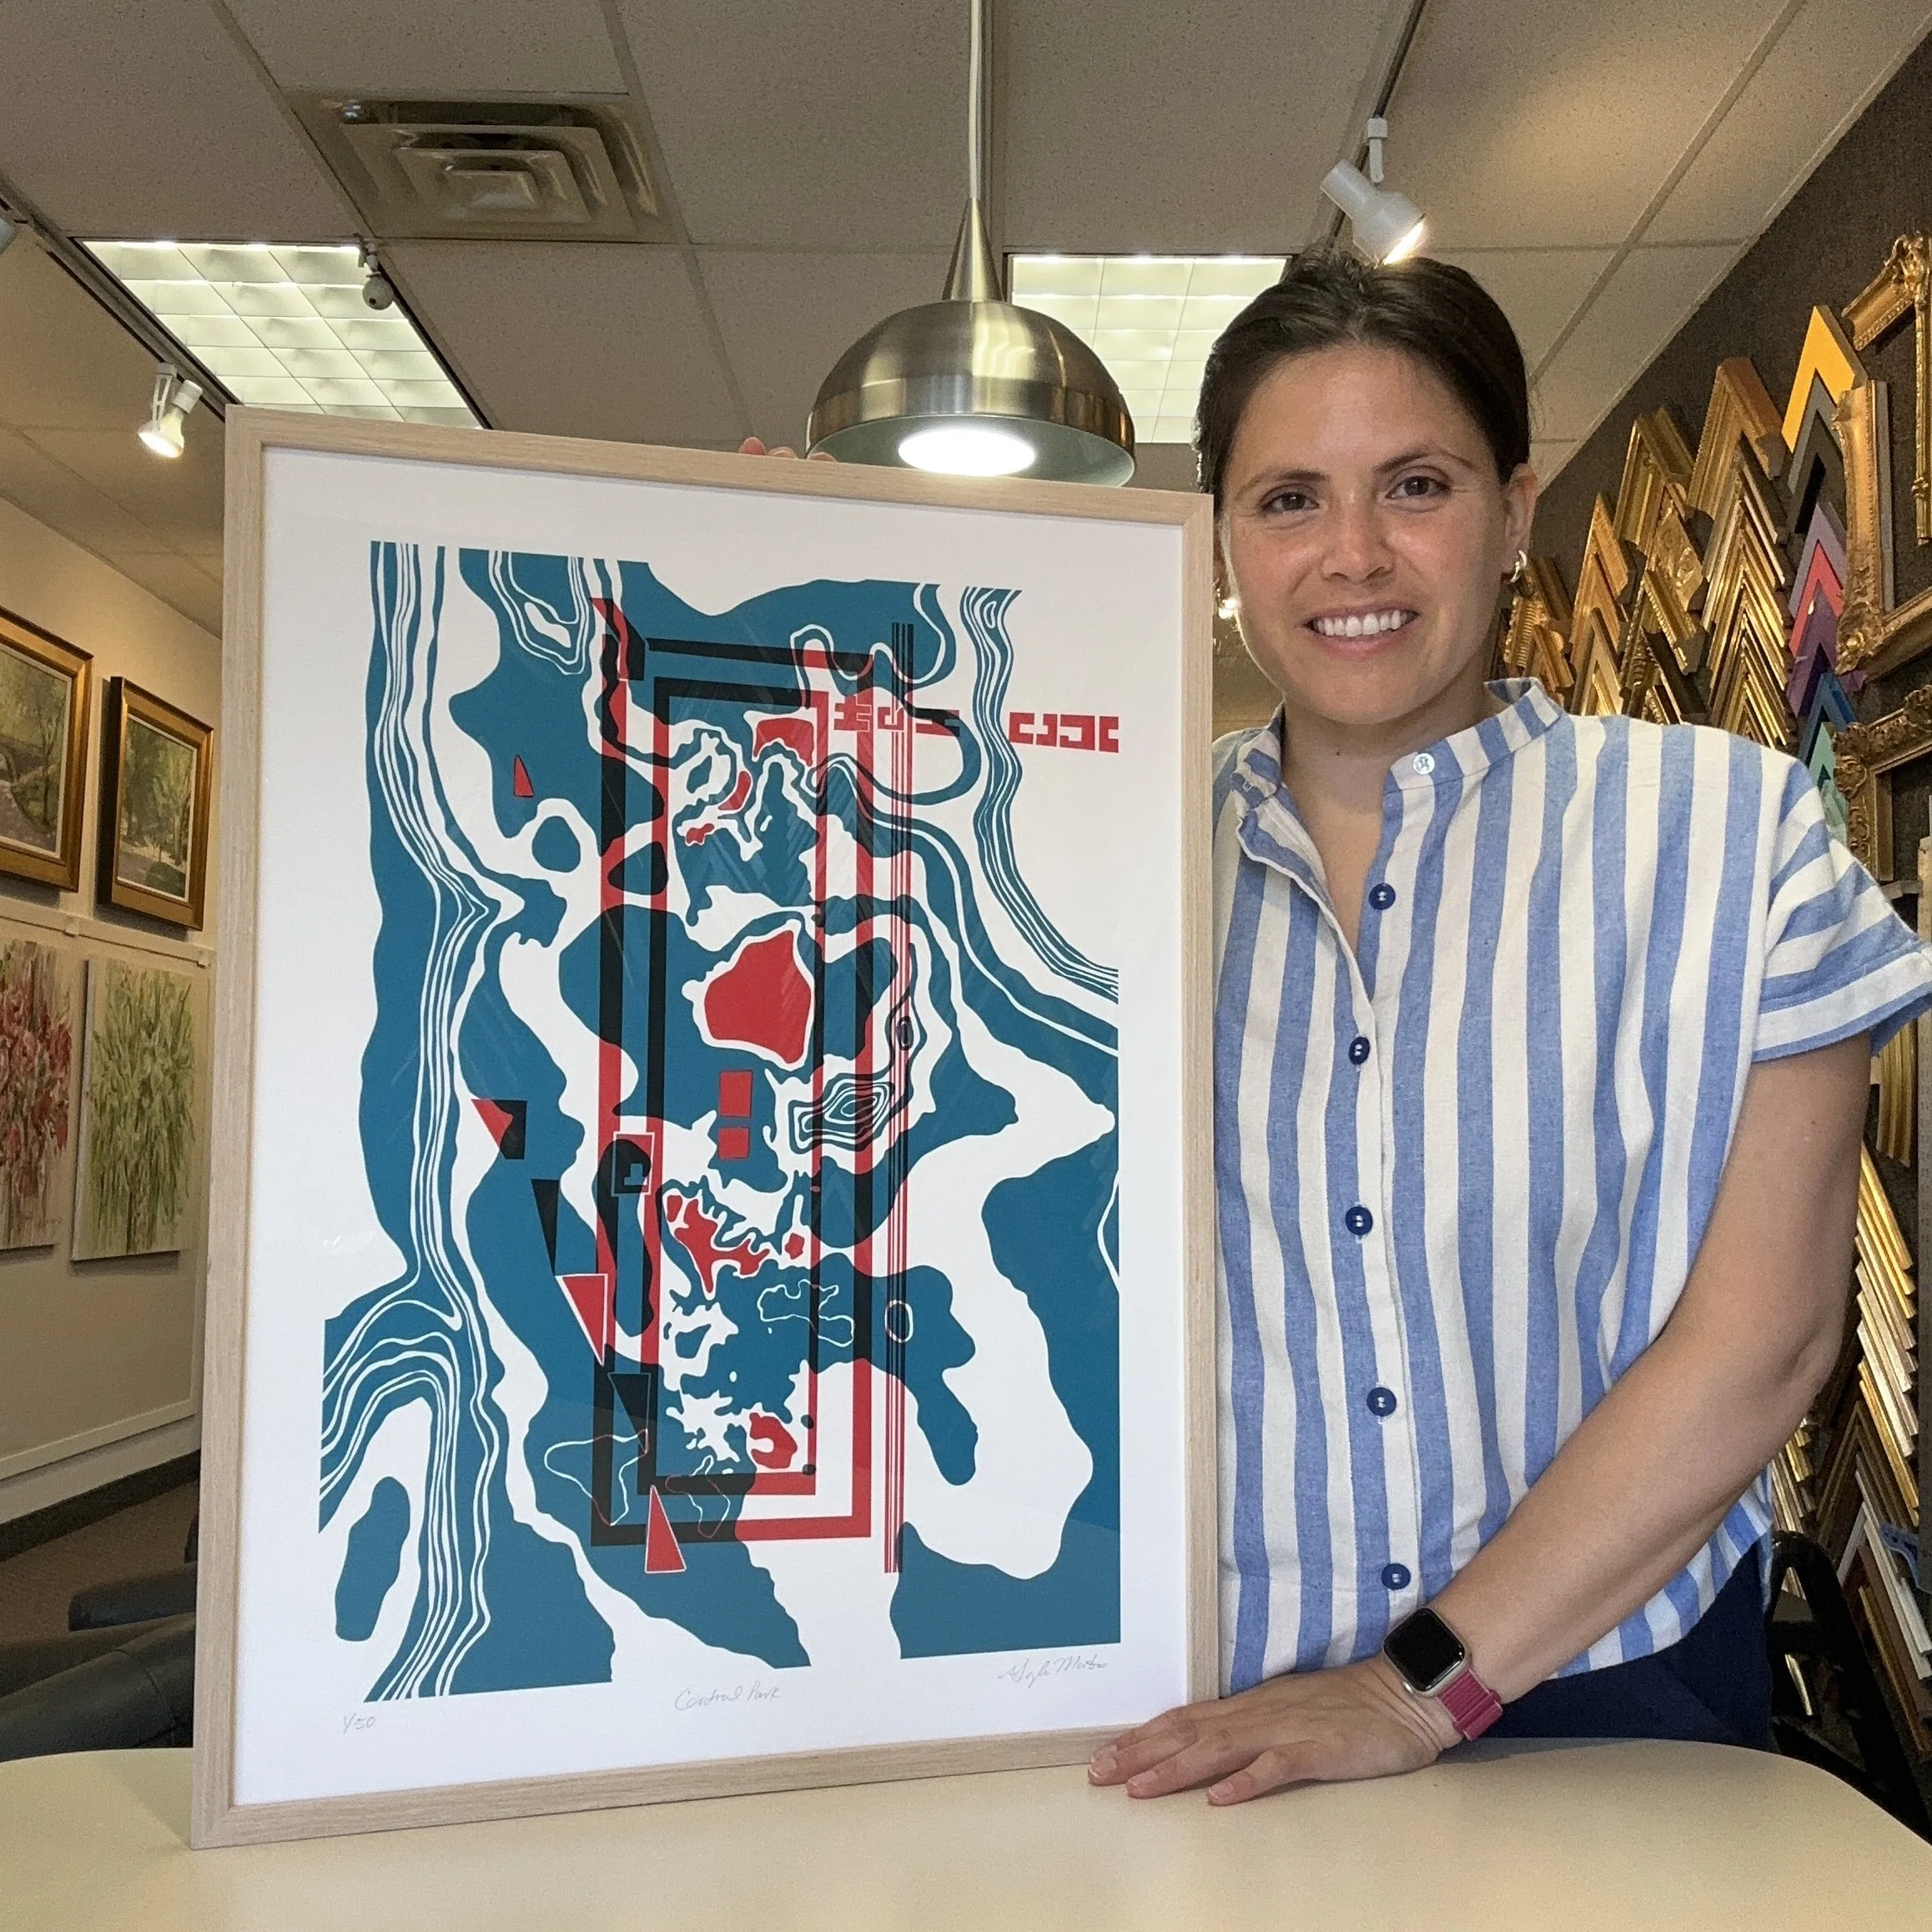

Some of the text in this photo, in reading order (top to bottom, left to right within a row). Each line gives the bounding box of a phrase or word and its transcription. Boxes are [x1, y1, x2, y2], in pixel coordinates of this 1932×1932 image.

[675, 1680, 781, 1711] Central Park
[343, 1712, 376, 1734] 1/50
